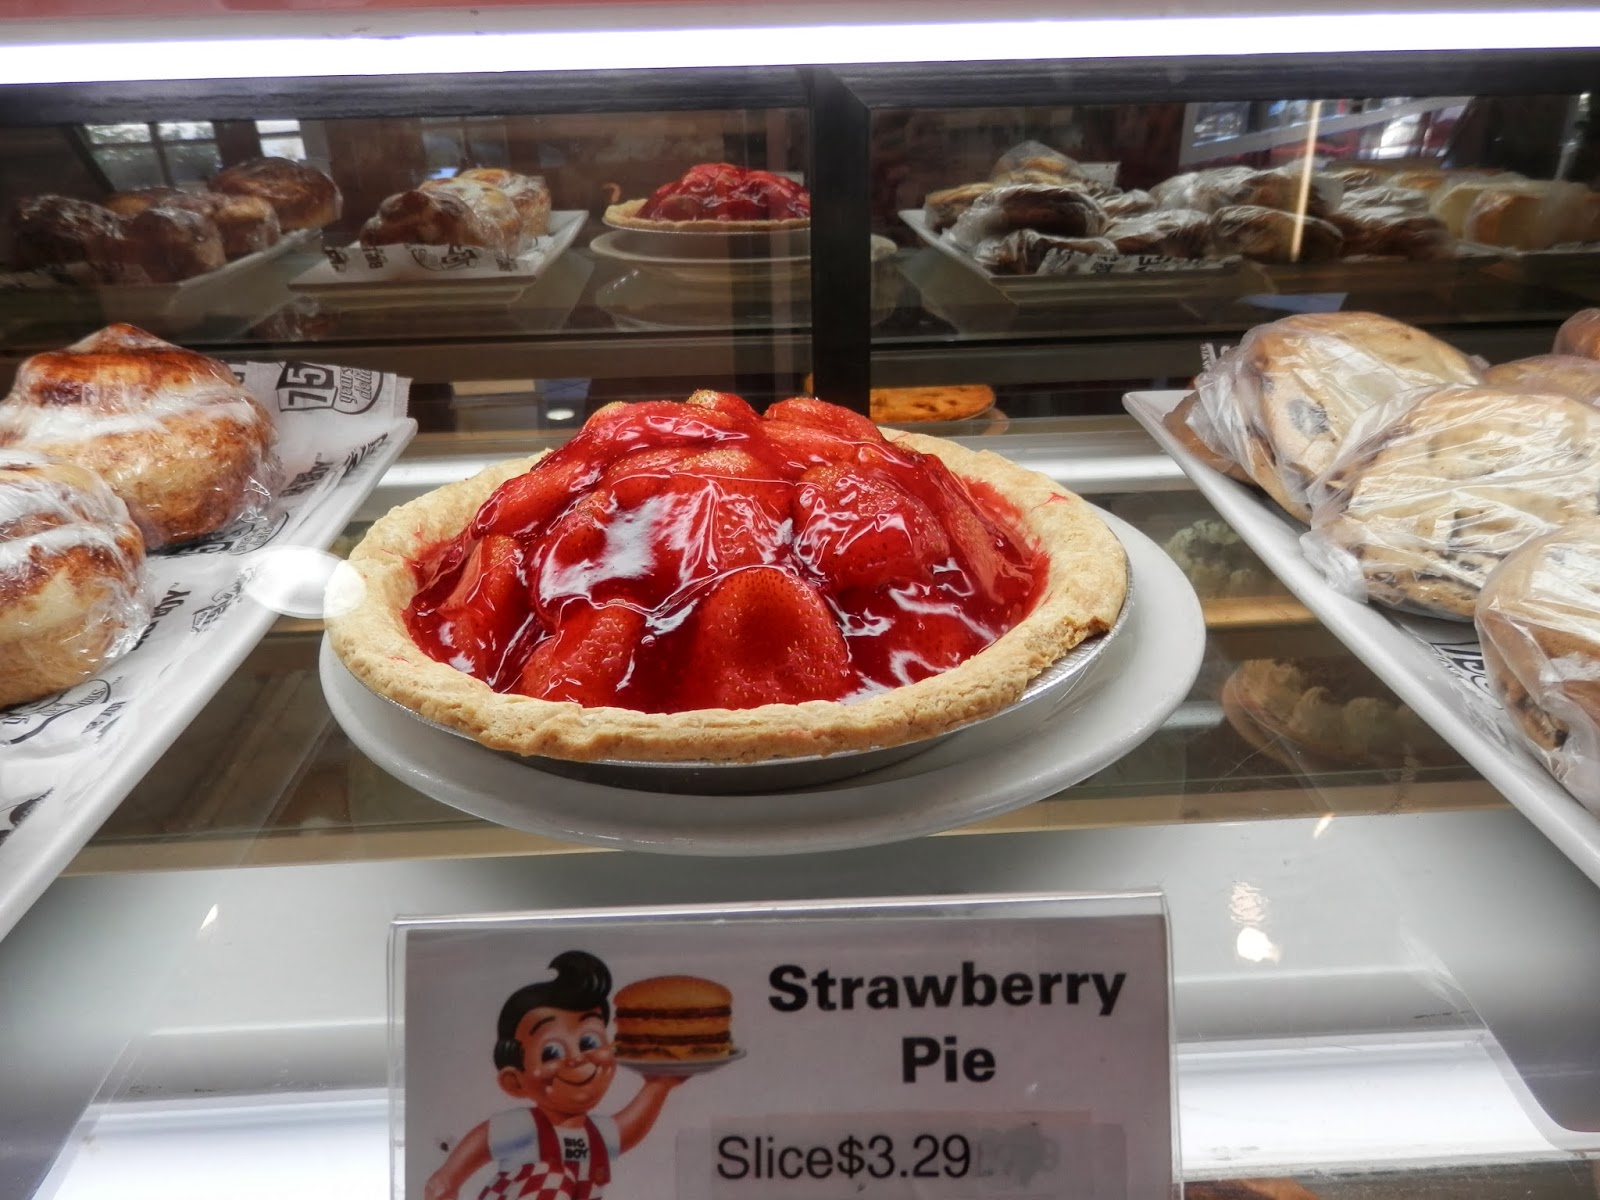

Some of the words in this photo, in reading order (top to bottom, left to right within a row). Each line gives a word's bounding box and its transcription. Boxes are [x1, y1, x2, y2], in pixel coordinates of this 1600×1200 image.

[286, 366, 327, 406] 75
[767, 960, 1127, 1017] Strawberry
[902, 1035, 996, 1084] Pie
[565, 1148, 590, 1160] BOY
[716, 1133, 971, 1180] Slice$3.29
